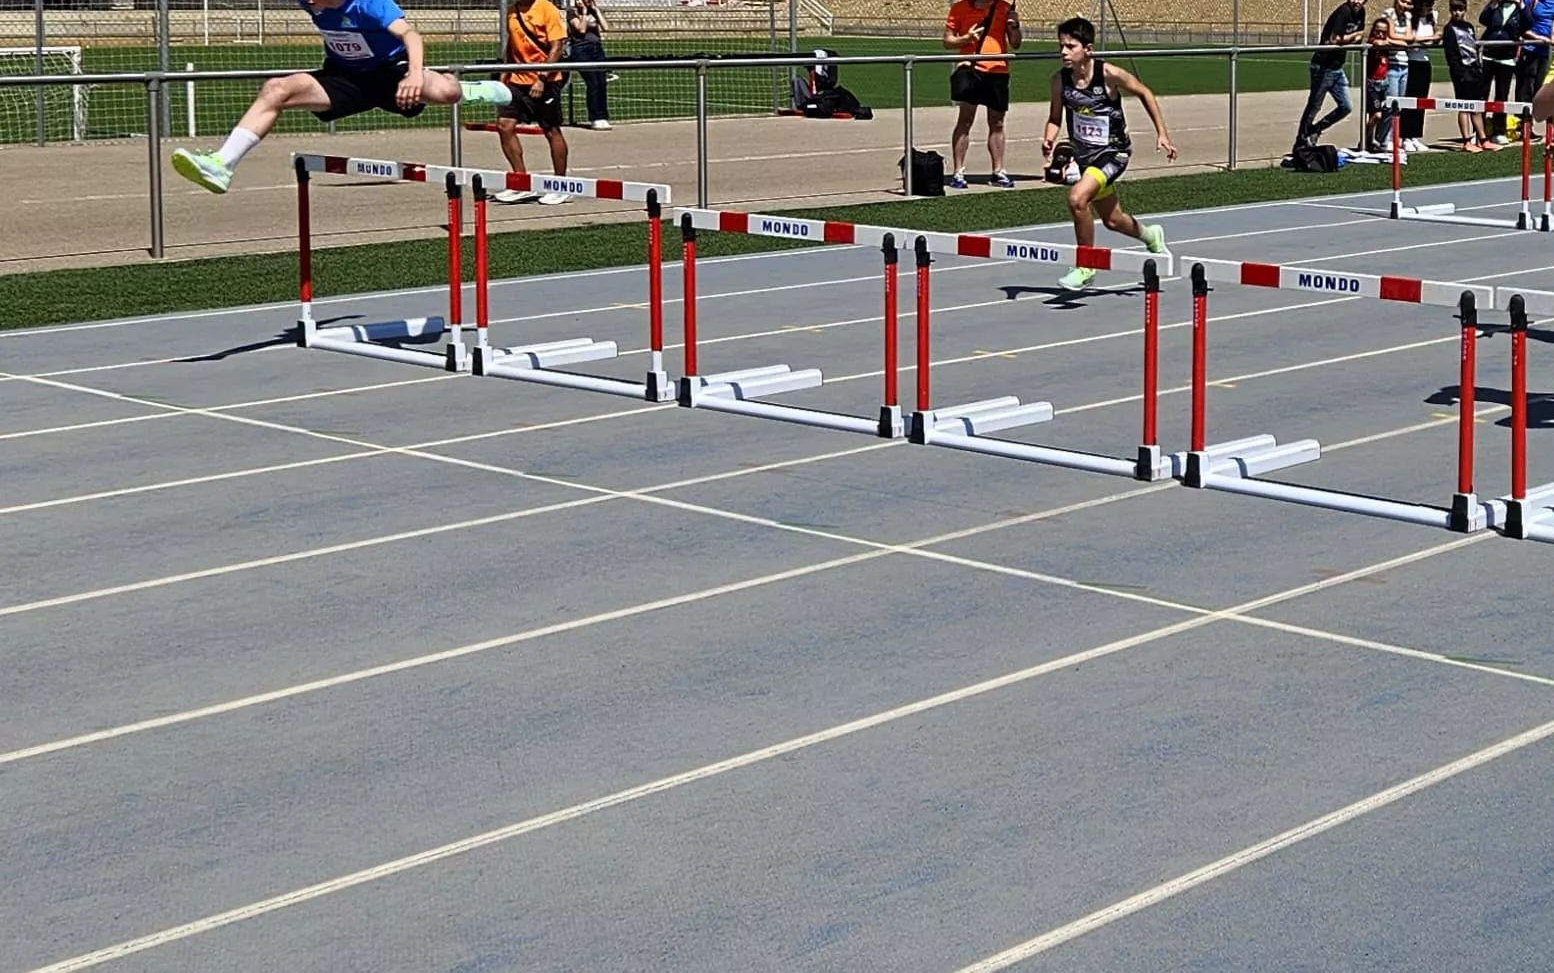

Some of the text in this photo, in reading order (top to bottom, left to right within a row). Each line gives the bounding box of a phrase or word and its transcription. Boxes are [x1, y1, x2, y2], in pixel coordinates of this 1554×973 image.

[329, 42, 362, 52] 1079
[1444, 101, 1475, 110] MONDO
[357, 162, 393, 176] MONDO
[543, 179, 583, 194] MONDO
[762, 220, 809, 237] MONDO
[1006, 244, 1059, 262] MONDO
[1298, 273, 1360, 293] MONDO
